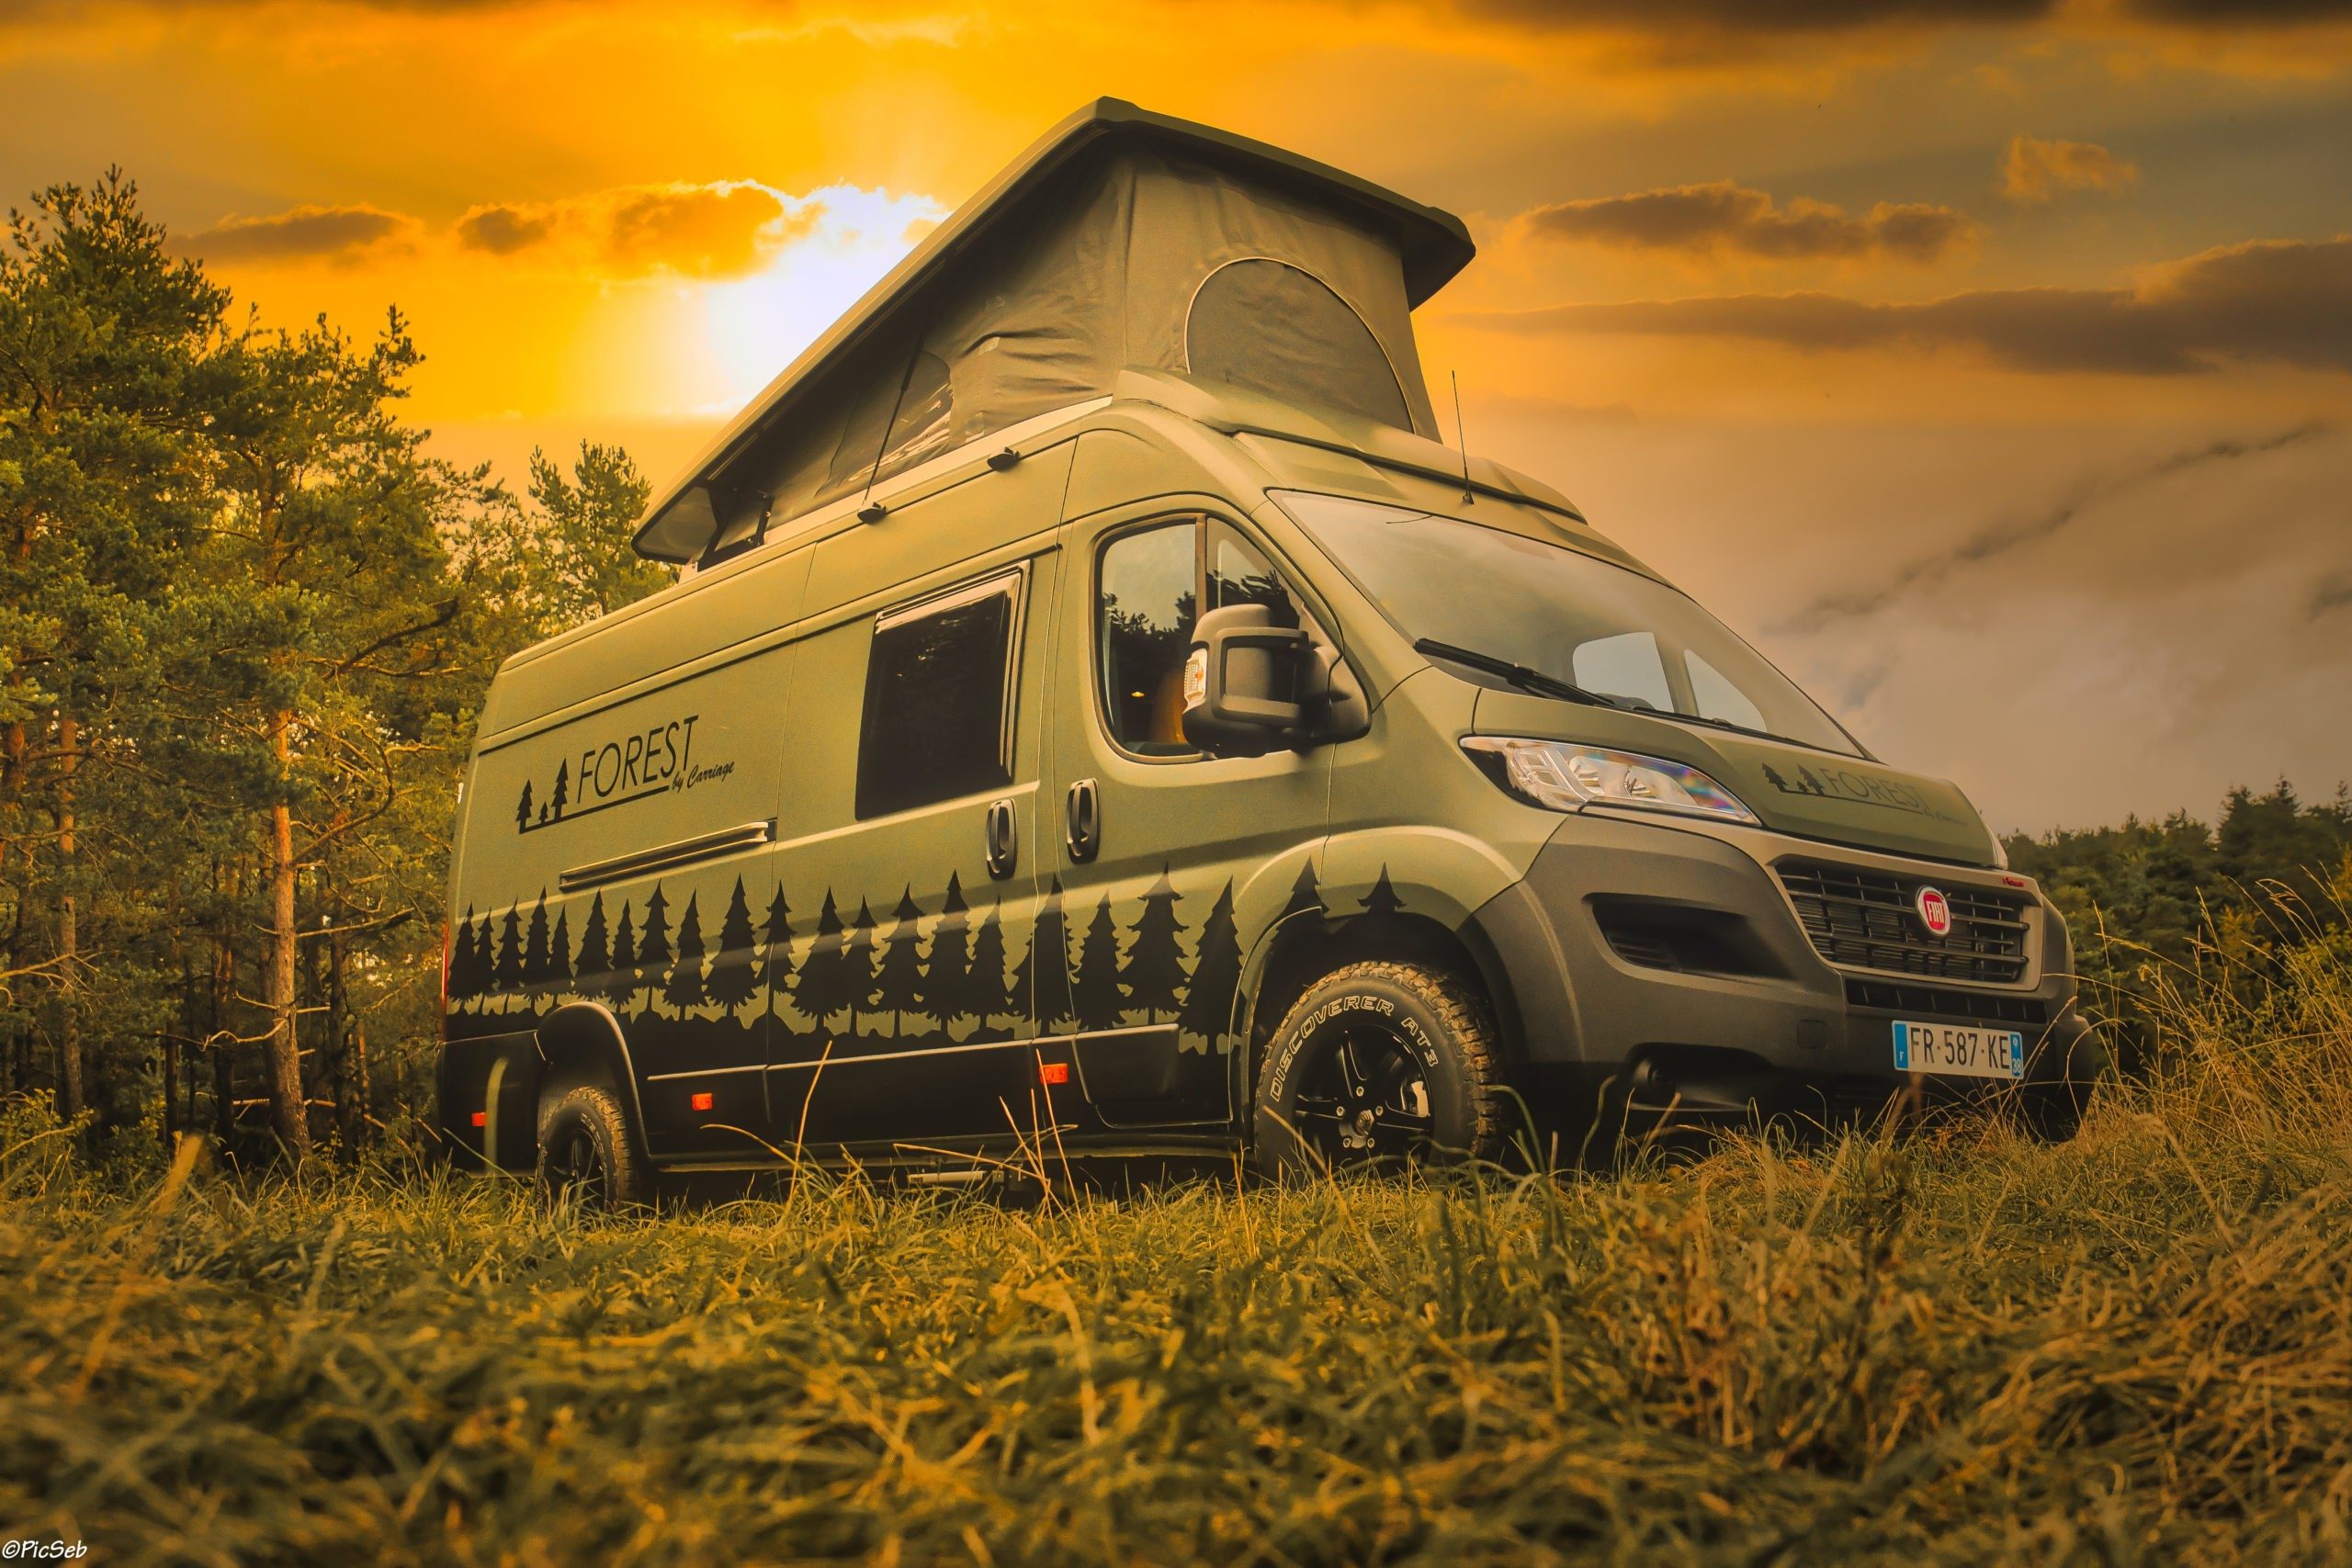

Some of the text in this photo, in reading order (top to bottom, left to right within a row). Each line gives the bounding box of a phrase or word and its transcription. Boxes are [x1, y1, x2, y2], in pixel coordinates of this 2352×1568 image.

[577, 715, 699, 804] FOREST
[672, 761, 735, 793] by Carriage
[1819, 768, 1930, 812] FOREST
[1926, 900, 1945, 923] FIAT
[1270, 995, 1395, 1102] DISCOVERER
[1910, 1027, 2009, 1069] FR-587-KE
[2012, 1057, 2022, 1074] 38
